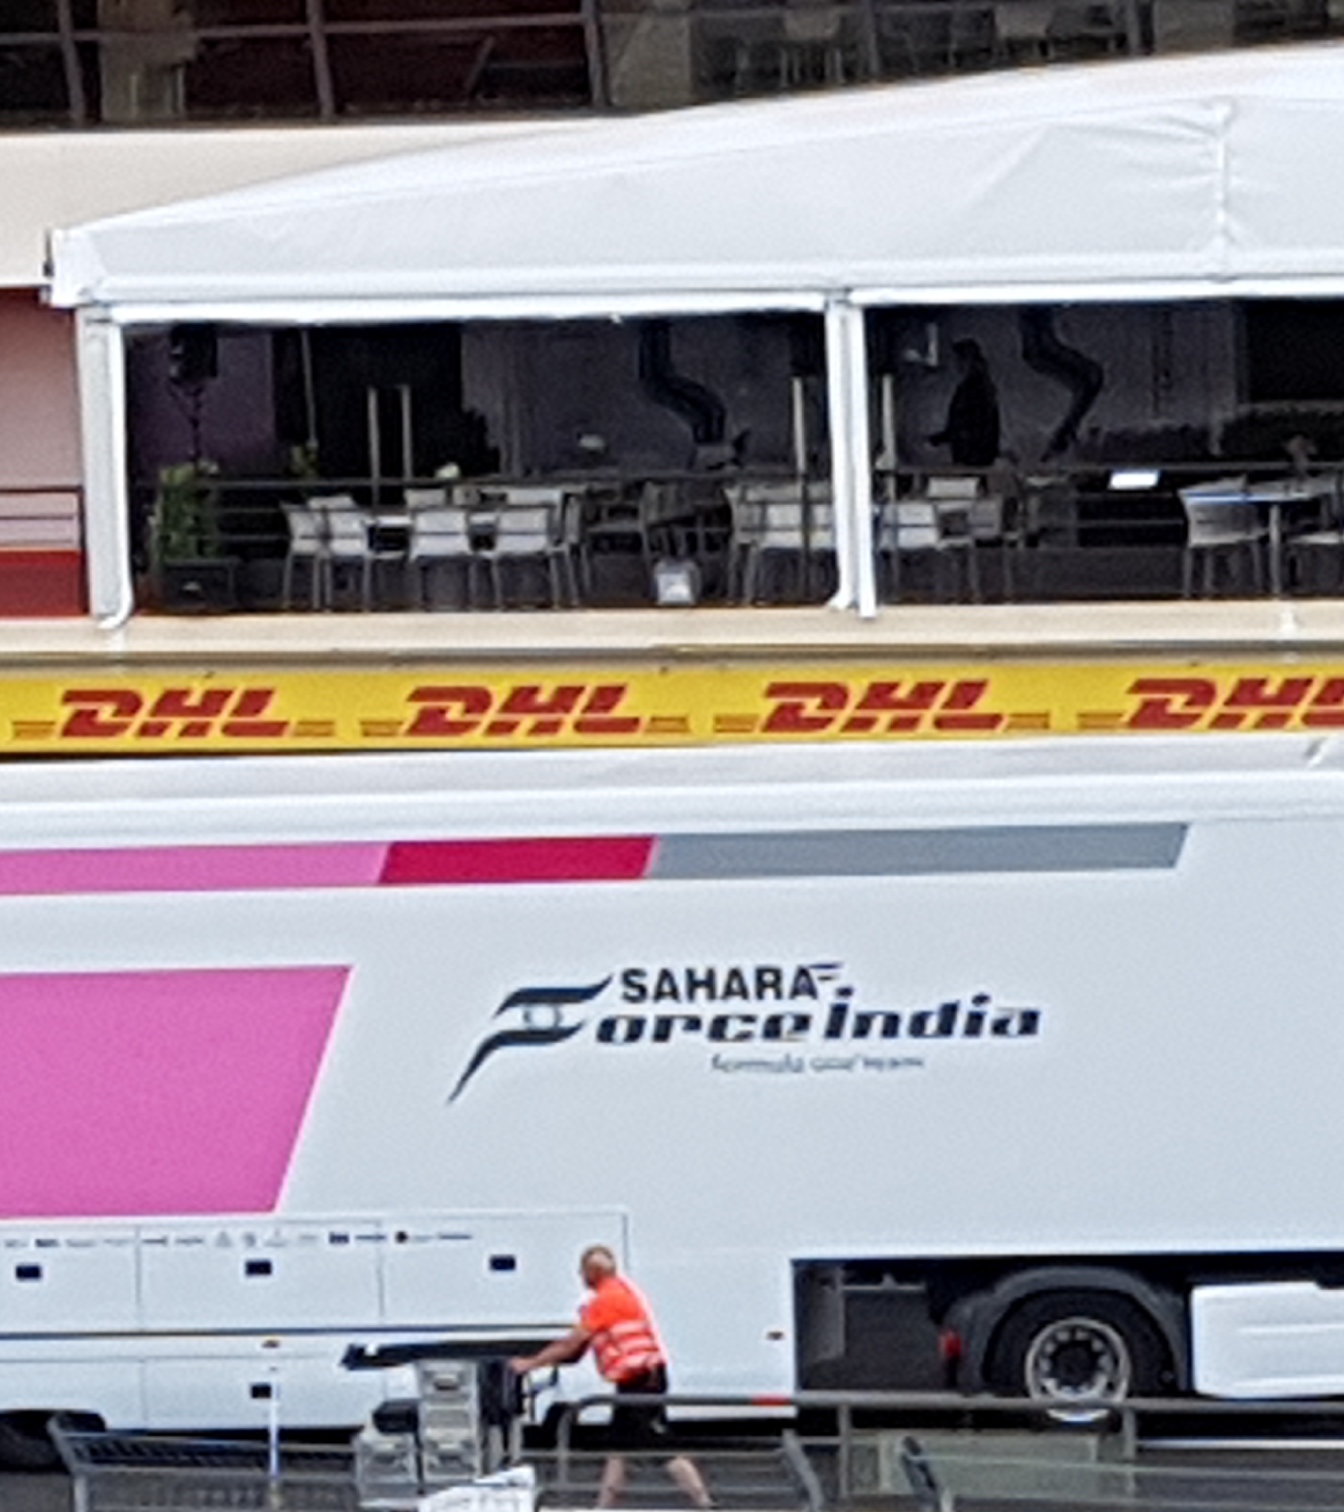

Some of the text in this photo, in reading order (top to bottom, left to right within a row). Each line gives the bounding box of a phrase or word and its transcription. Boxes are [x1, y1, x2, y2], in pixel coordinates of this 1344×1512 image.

[59, 689, 290, 737] DHL
[406, 685, 642, 736] DHL
[762, 681, 1003, 732] DHL
[621, 967, 821, 1003] SAHARA
